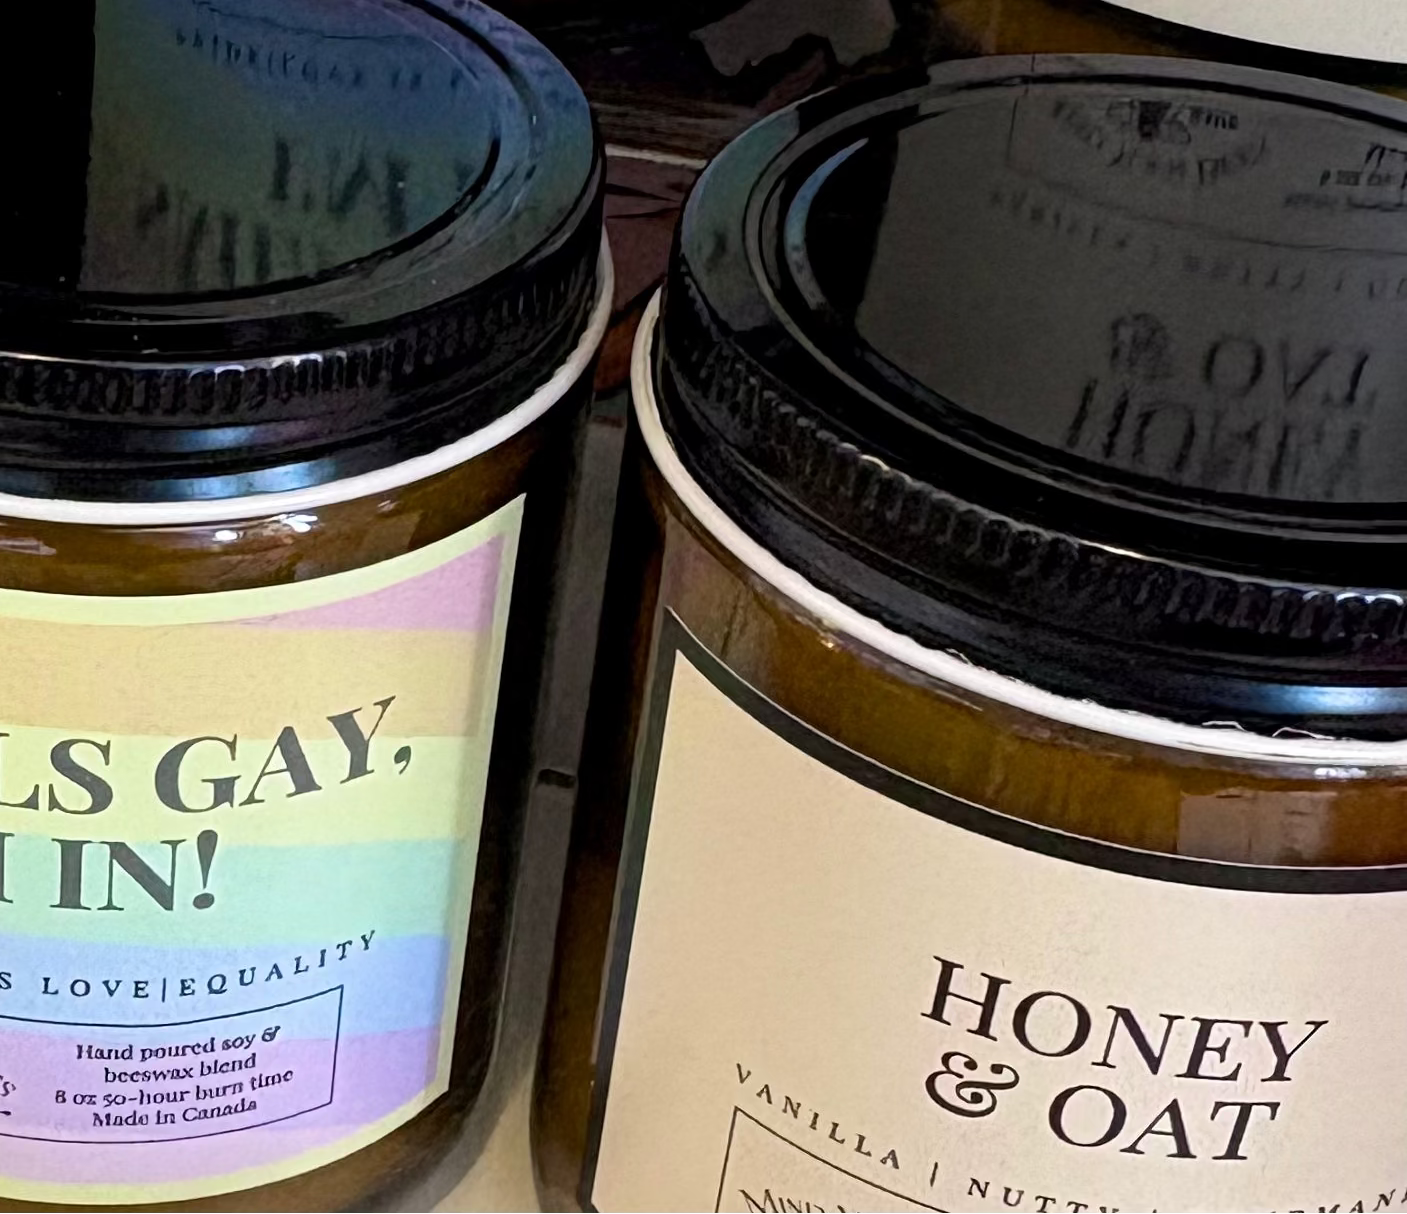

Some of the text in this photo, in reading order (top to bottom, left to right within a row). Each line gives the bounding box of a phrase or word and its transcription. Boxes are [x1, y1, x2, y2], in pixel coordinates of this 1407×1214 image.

[153, 695, 412, 814] GAY,
[49, 829, 218, 912] IN!
[76, 1025, 281, 1063] Hand poured soy &
[921, 955, 1328, 1083] HONEY
[54, 1089, 67, 1104] 8
[73, 1093, 98, 1106] oz
[195, 1082, 244, 1101] burn
[250, 1070, 294, 1092] time
[104, 1052, 257, 1084] beeswax blend
[925, 1050, 1280, 1161] & OAT
[92, 1111, 149, 1128] Made
[182, 1098, 257, 1123] Canada
[737, 1062, 900, 1170] VANILLA
